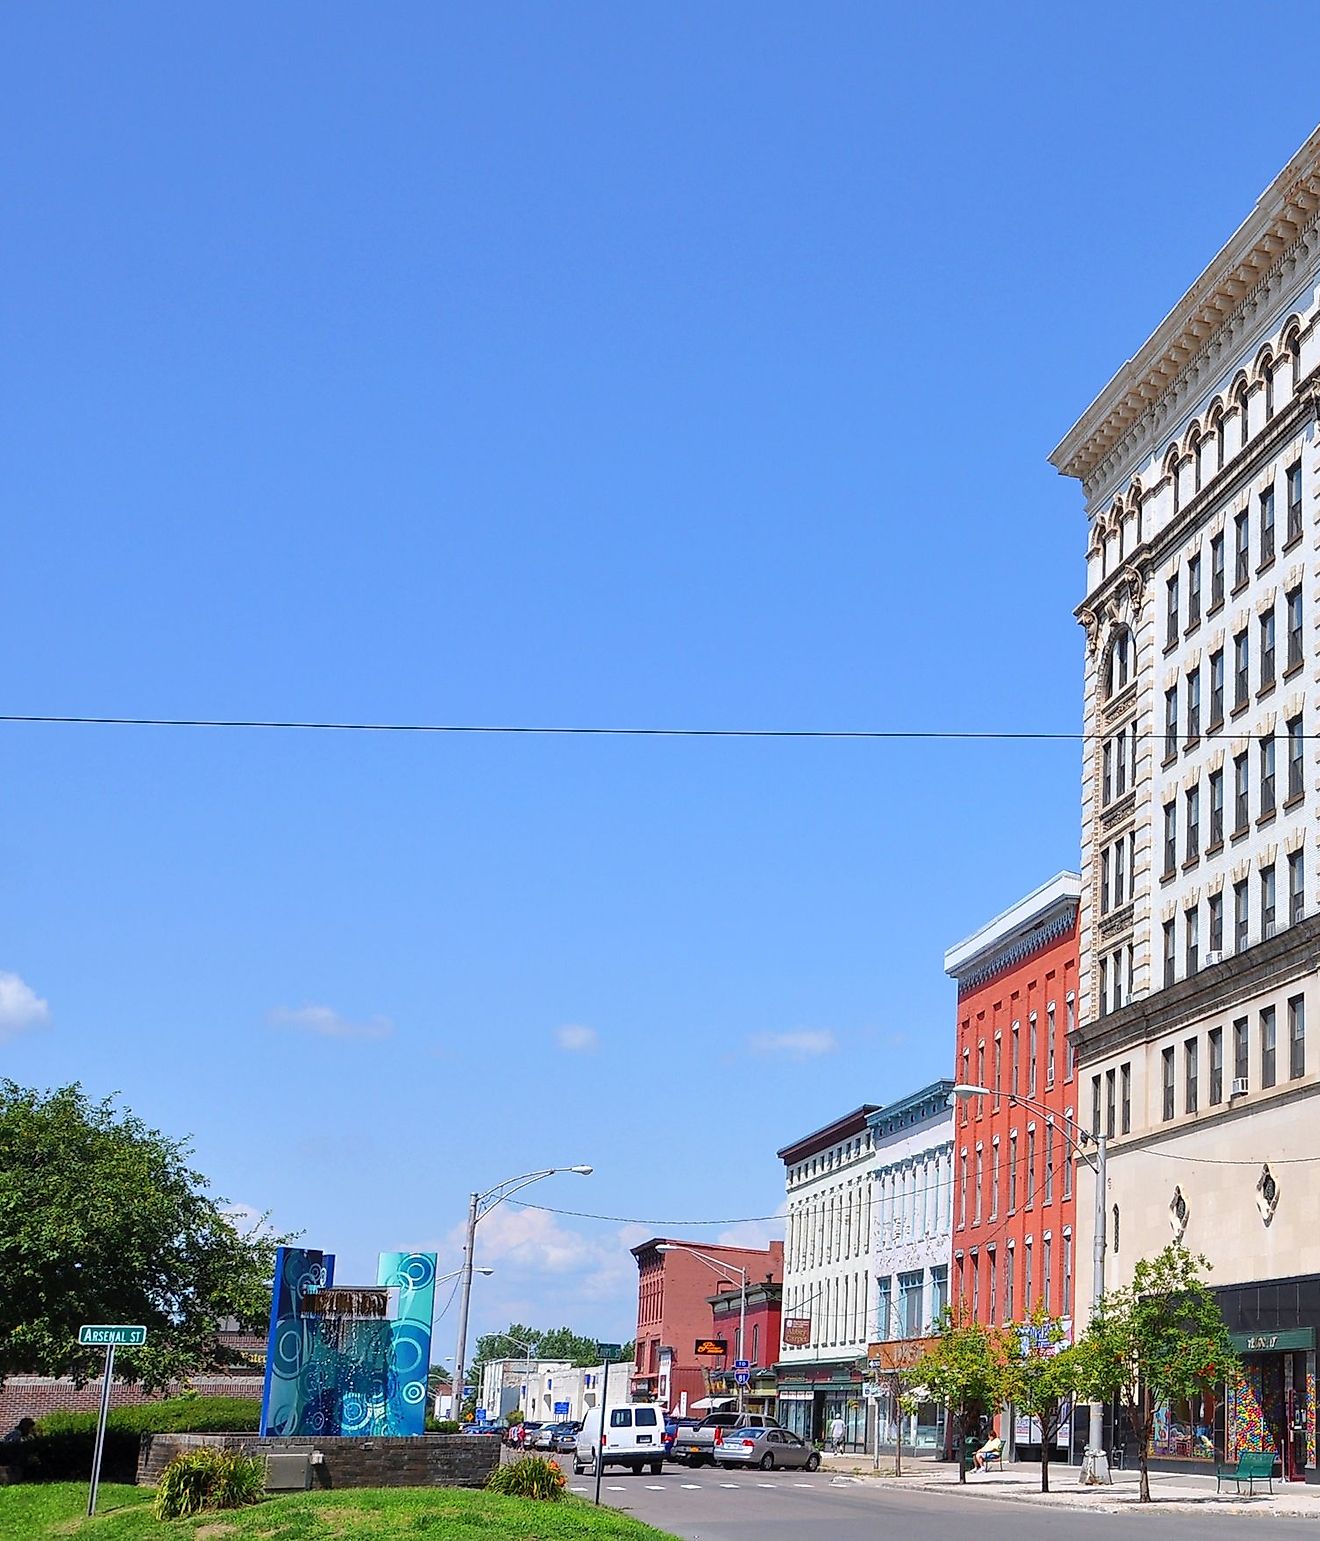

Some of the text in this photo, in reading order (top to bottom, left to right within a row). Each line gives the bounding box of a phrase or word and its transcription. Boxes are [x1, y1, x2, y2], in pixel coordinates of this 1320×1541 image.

[83, 1328, 142, 1343] ARSENAL ST
[738, 1374, 746, 1382] 81
